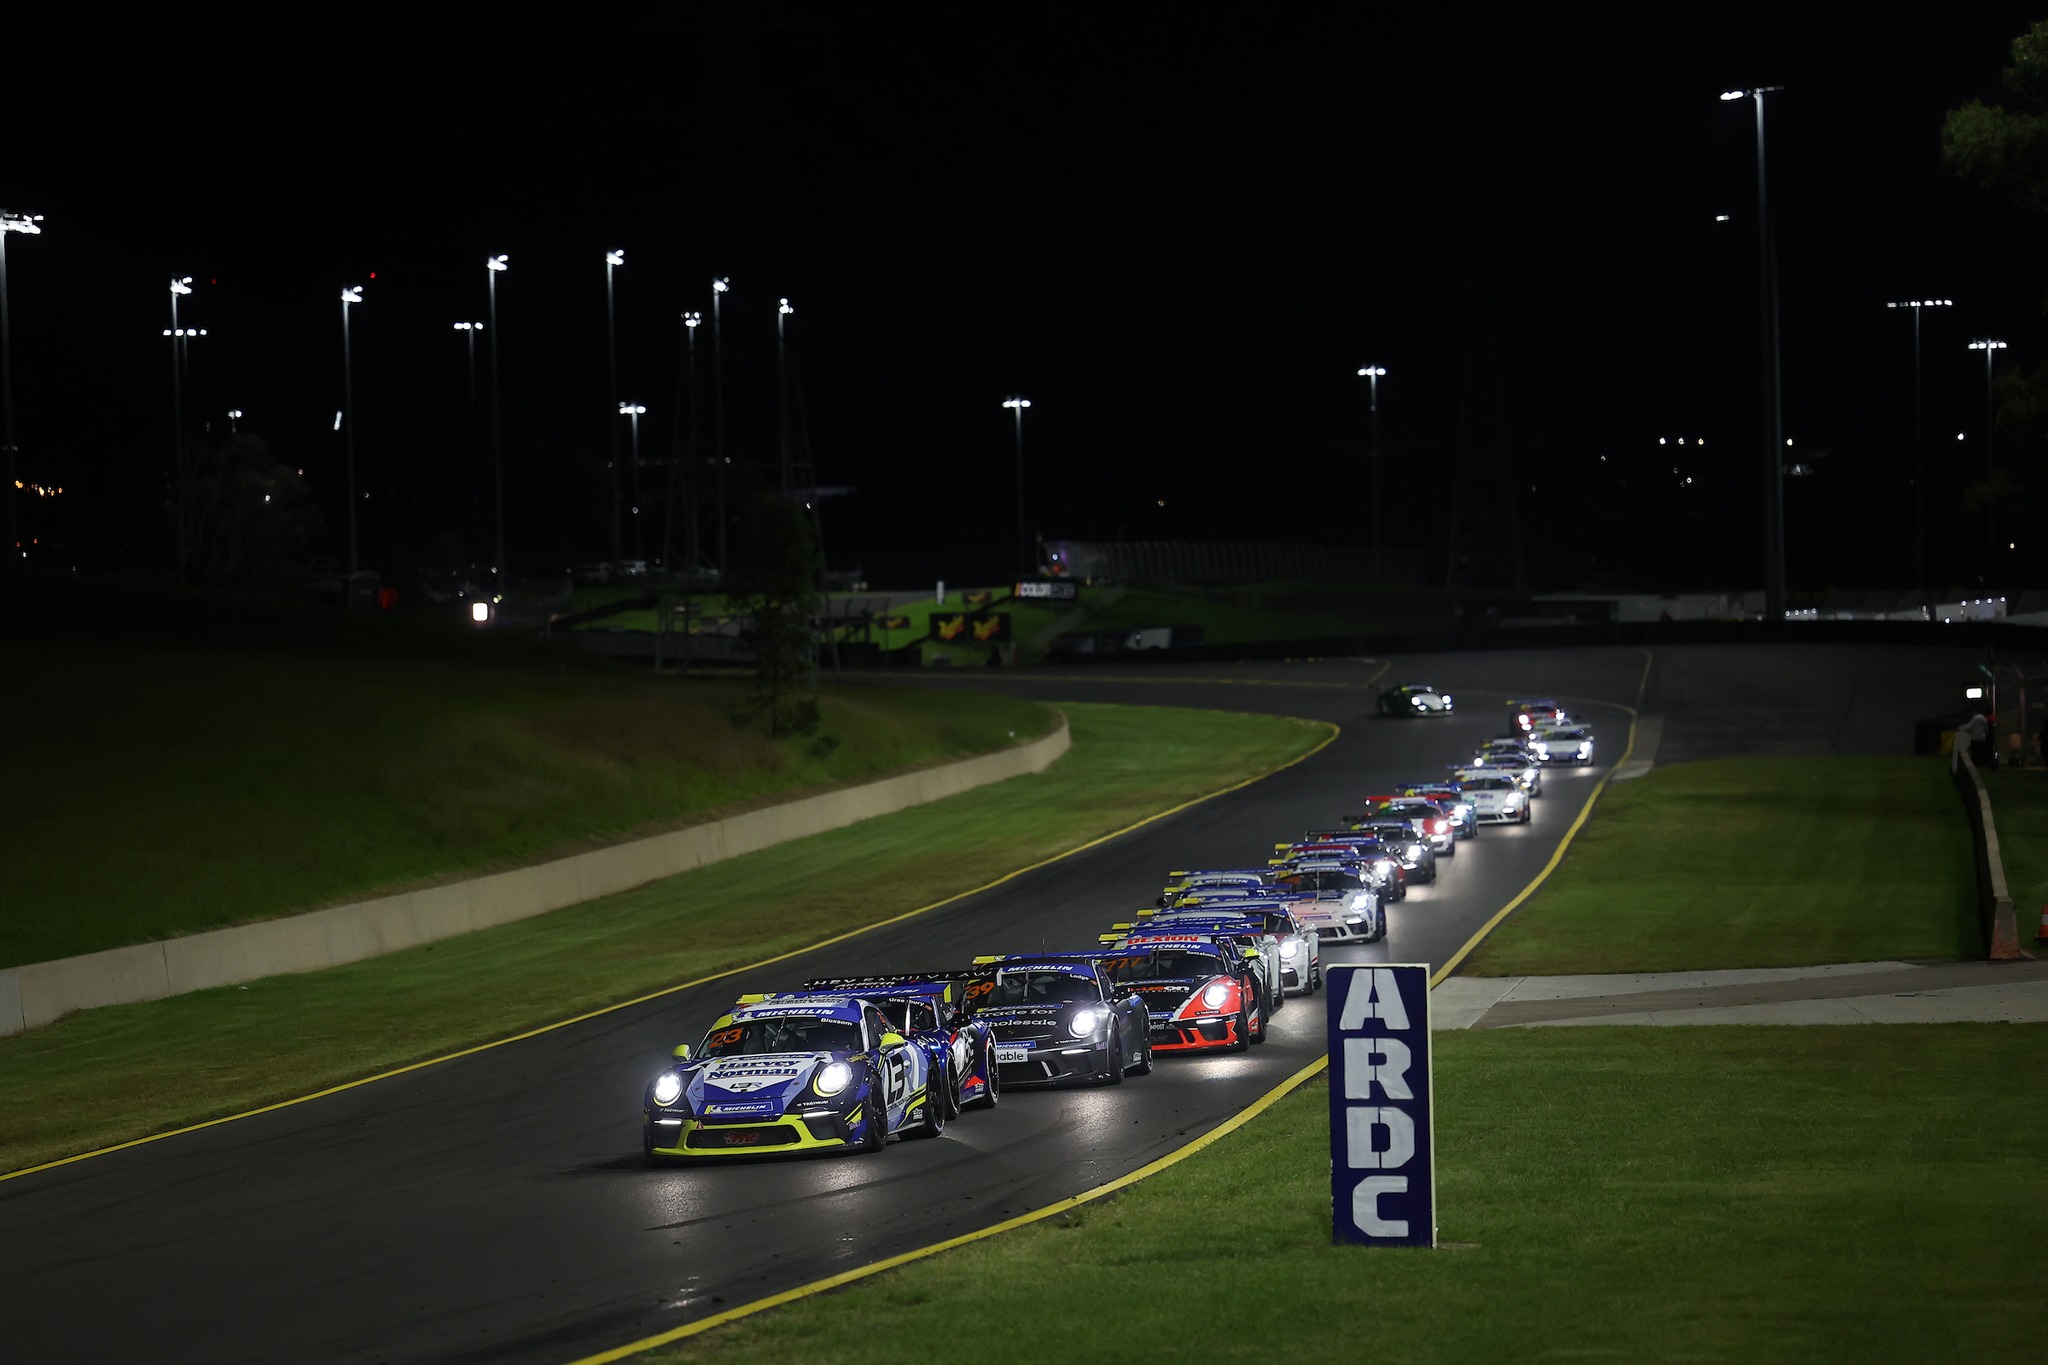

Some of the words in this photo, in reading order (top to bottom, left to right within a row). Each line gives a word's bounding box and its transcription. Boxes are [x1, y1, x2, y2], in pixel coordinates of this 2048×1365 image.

[964, 982, 994, 999] 39
[756, 1008, 835, 1018] MICHELIN
[973, 1009, 1027, 1019] Trade
[1030, 1008, 1057, 1016] for
[821, 1017, 853, 1026] Bloxsom
[983, 1018, 1057, 1028] holesale
[708, 1028, 743, 1049] 23
[716, 1060, 801, 1071] Harvey
[707, 1068, 799, 1080] Norman
[723, 1103, 768, 1111] MICHELIN
[1339, 968, 1414, 1237] ARDC
